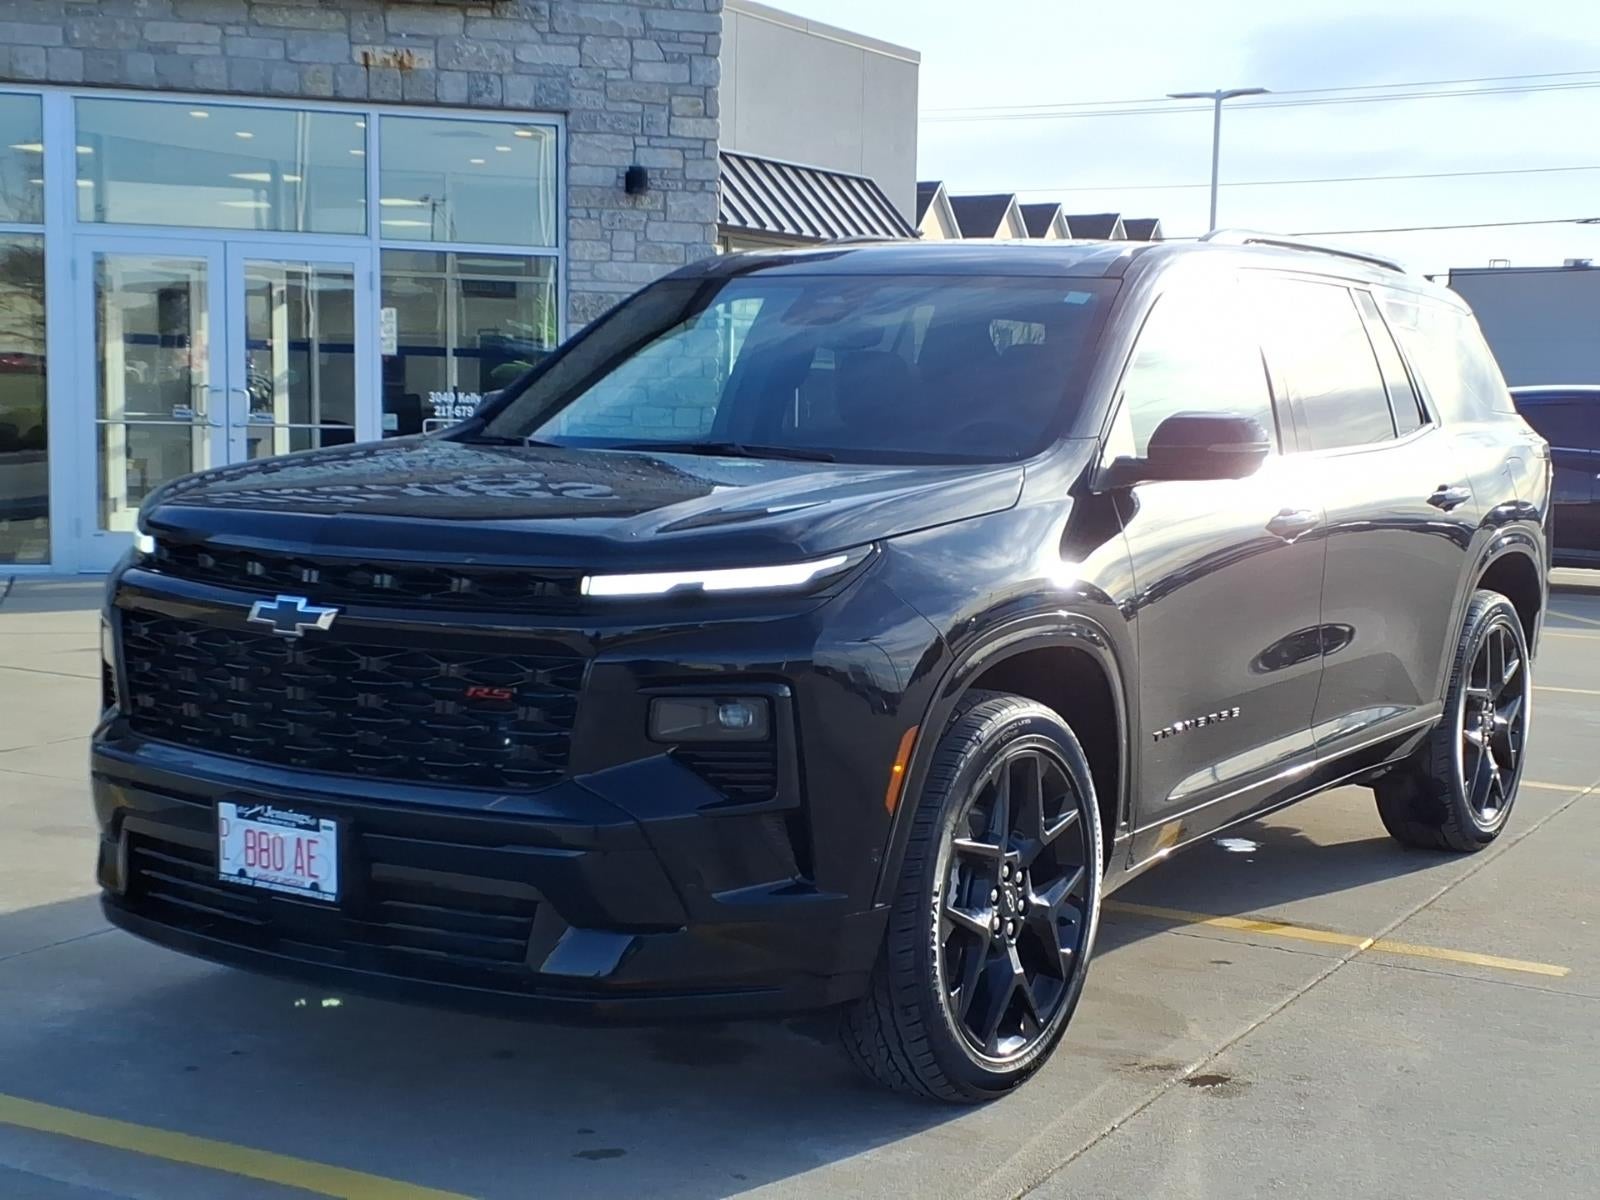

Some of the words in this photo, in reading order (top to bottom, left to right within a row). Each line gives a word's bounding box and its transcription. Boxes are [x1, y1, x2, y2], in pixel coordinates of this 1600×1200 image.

[428, 391, 456, 403] 3040
[457, 391, 482, 406] Kelly
[464, 687, 513, 699] RS
[1152, 706, 1240, 742] TRAVERSE
[295, 837, 319, 879] AE
